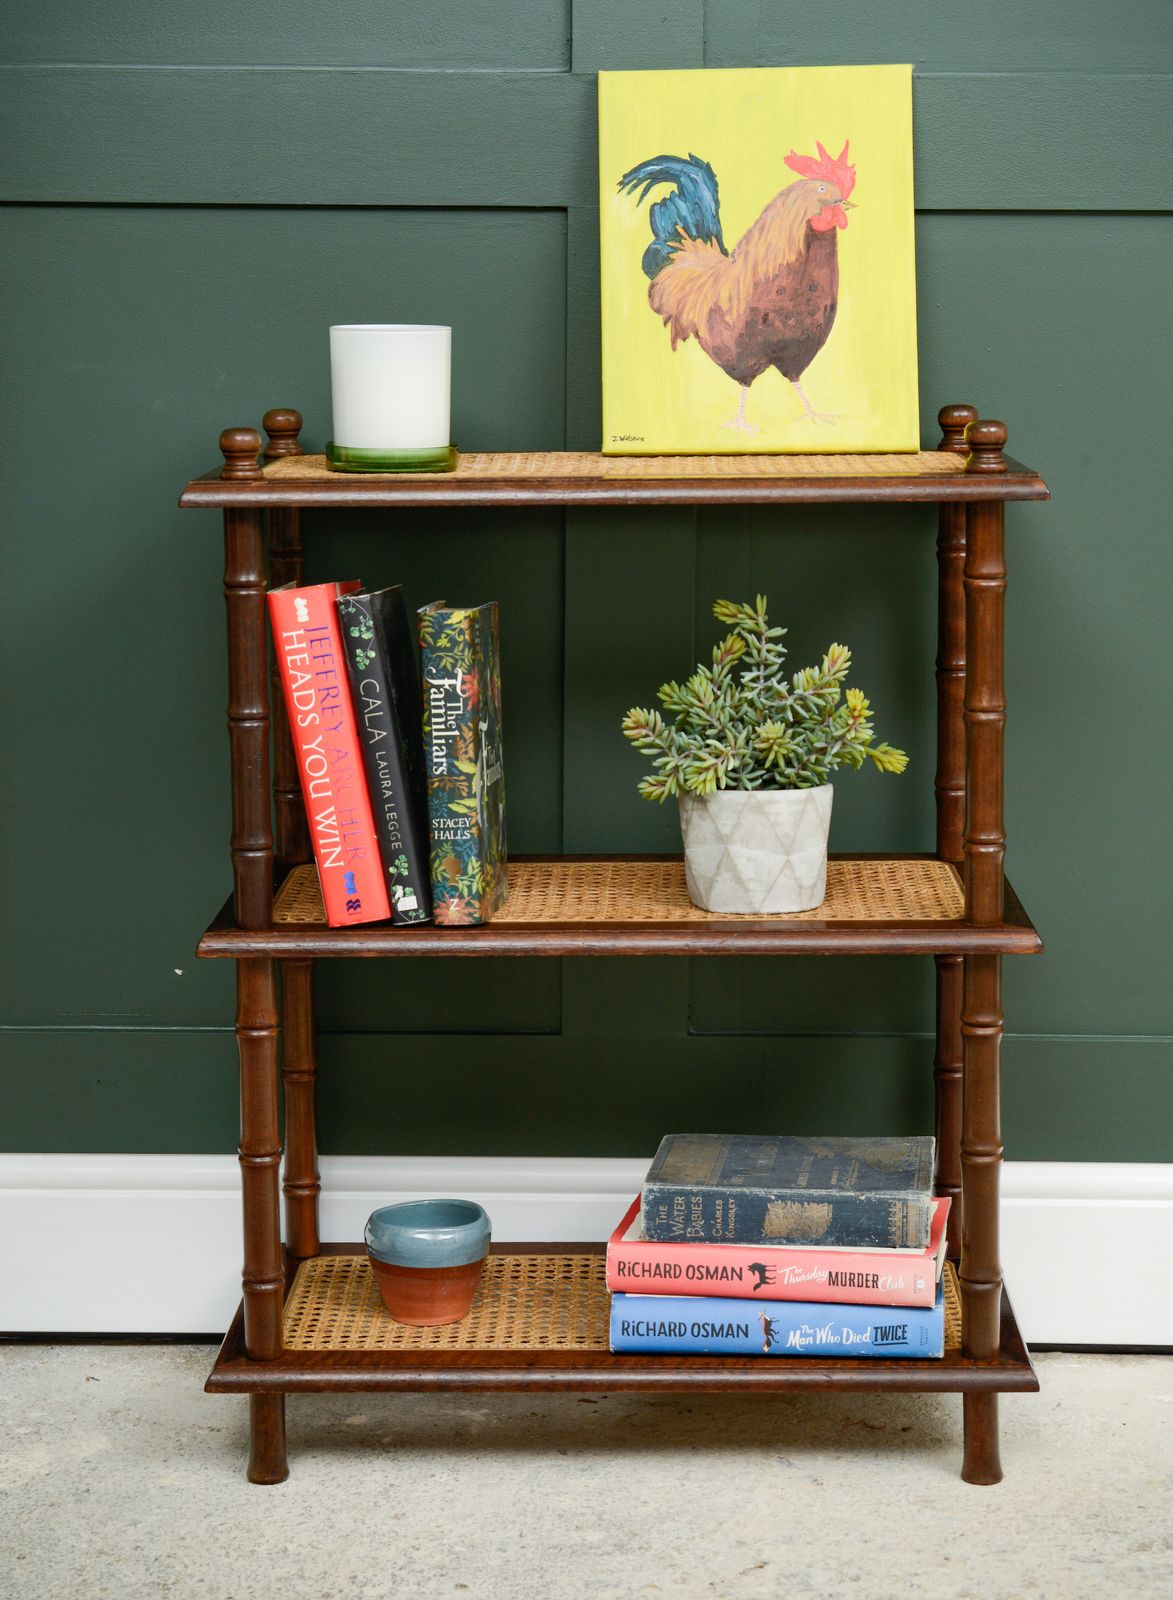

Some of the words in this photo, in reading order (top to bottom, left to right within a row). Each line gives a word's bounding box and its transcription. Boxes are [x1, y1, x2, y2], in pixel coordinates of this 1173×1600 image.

[282, 629, 319, 727] HEADS
[359, 678, 388, 744] CALA
[425, 666, 469, 776] Familiars
[446, 697, 464, 729] The
[304, 625, 347, 736] JEFFREY
[329, 745, 367, 864] ARCHER
[302, 735, 333, 800] YOU
[375, 751, 393, 799] LAURA
[384, 803, 403, 850] LEGGE
[315, 805, 344, 868] WIN
[432, 818, 472, 828] STACEY
[434, 830, 471, 840] HALLS
[656, 1204, 668, 1225] THE
[669, 1195, 686, 1236] WATER
[686, 1196, 704, 1237] BABIES
[712, 1199, 724, 1237] CHARLES
[725, 1198, 737, 1239] KINGSLEY
[685, 1264, 743, 1281] OSMAN
[778, 1265, 829, 1285] Thursday
[828, 1270, 880, 1289] MURDER
[878, 1275, 905, 1291] Club
[690, 1322, 749, 1339] OSMAN
[786, 1330, 814, 1350] Man
[800, 1324, 815, 1335] The
[815, 1322, 841, 1345] Who
[842, 1326, 871, 1345] Died
[873, 1324, 908, 1343] TWICE
